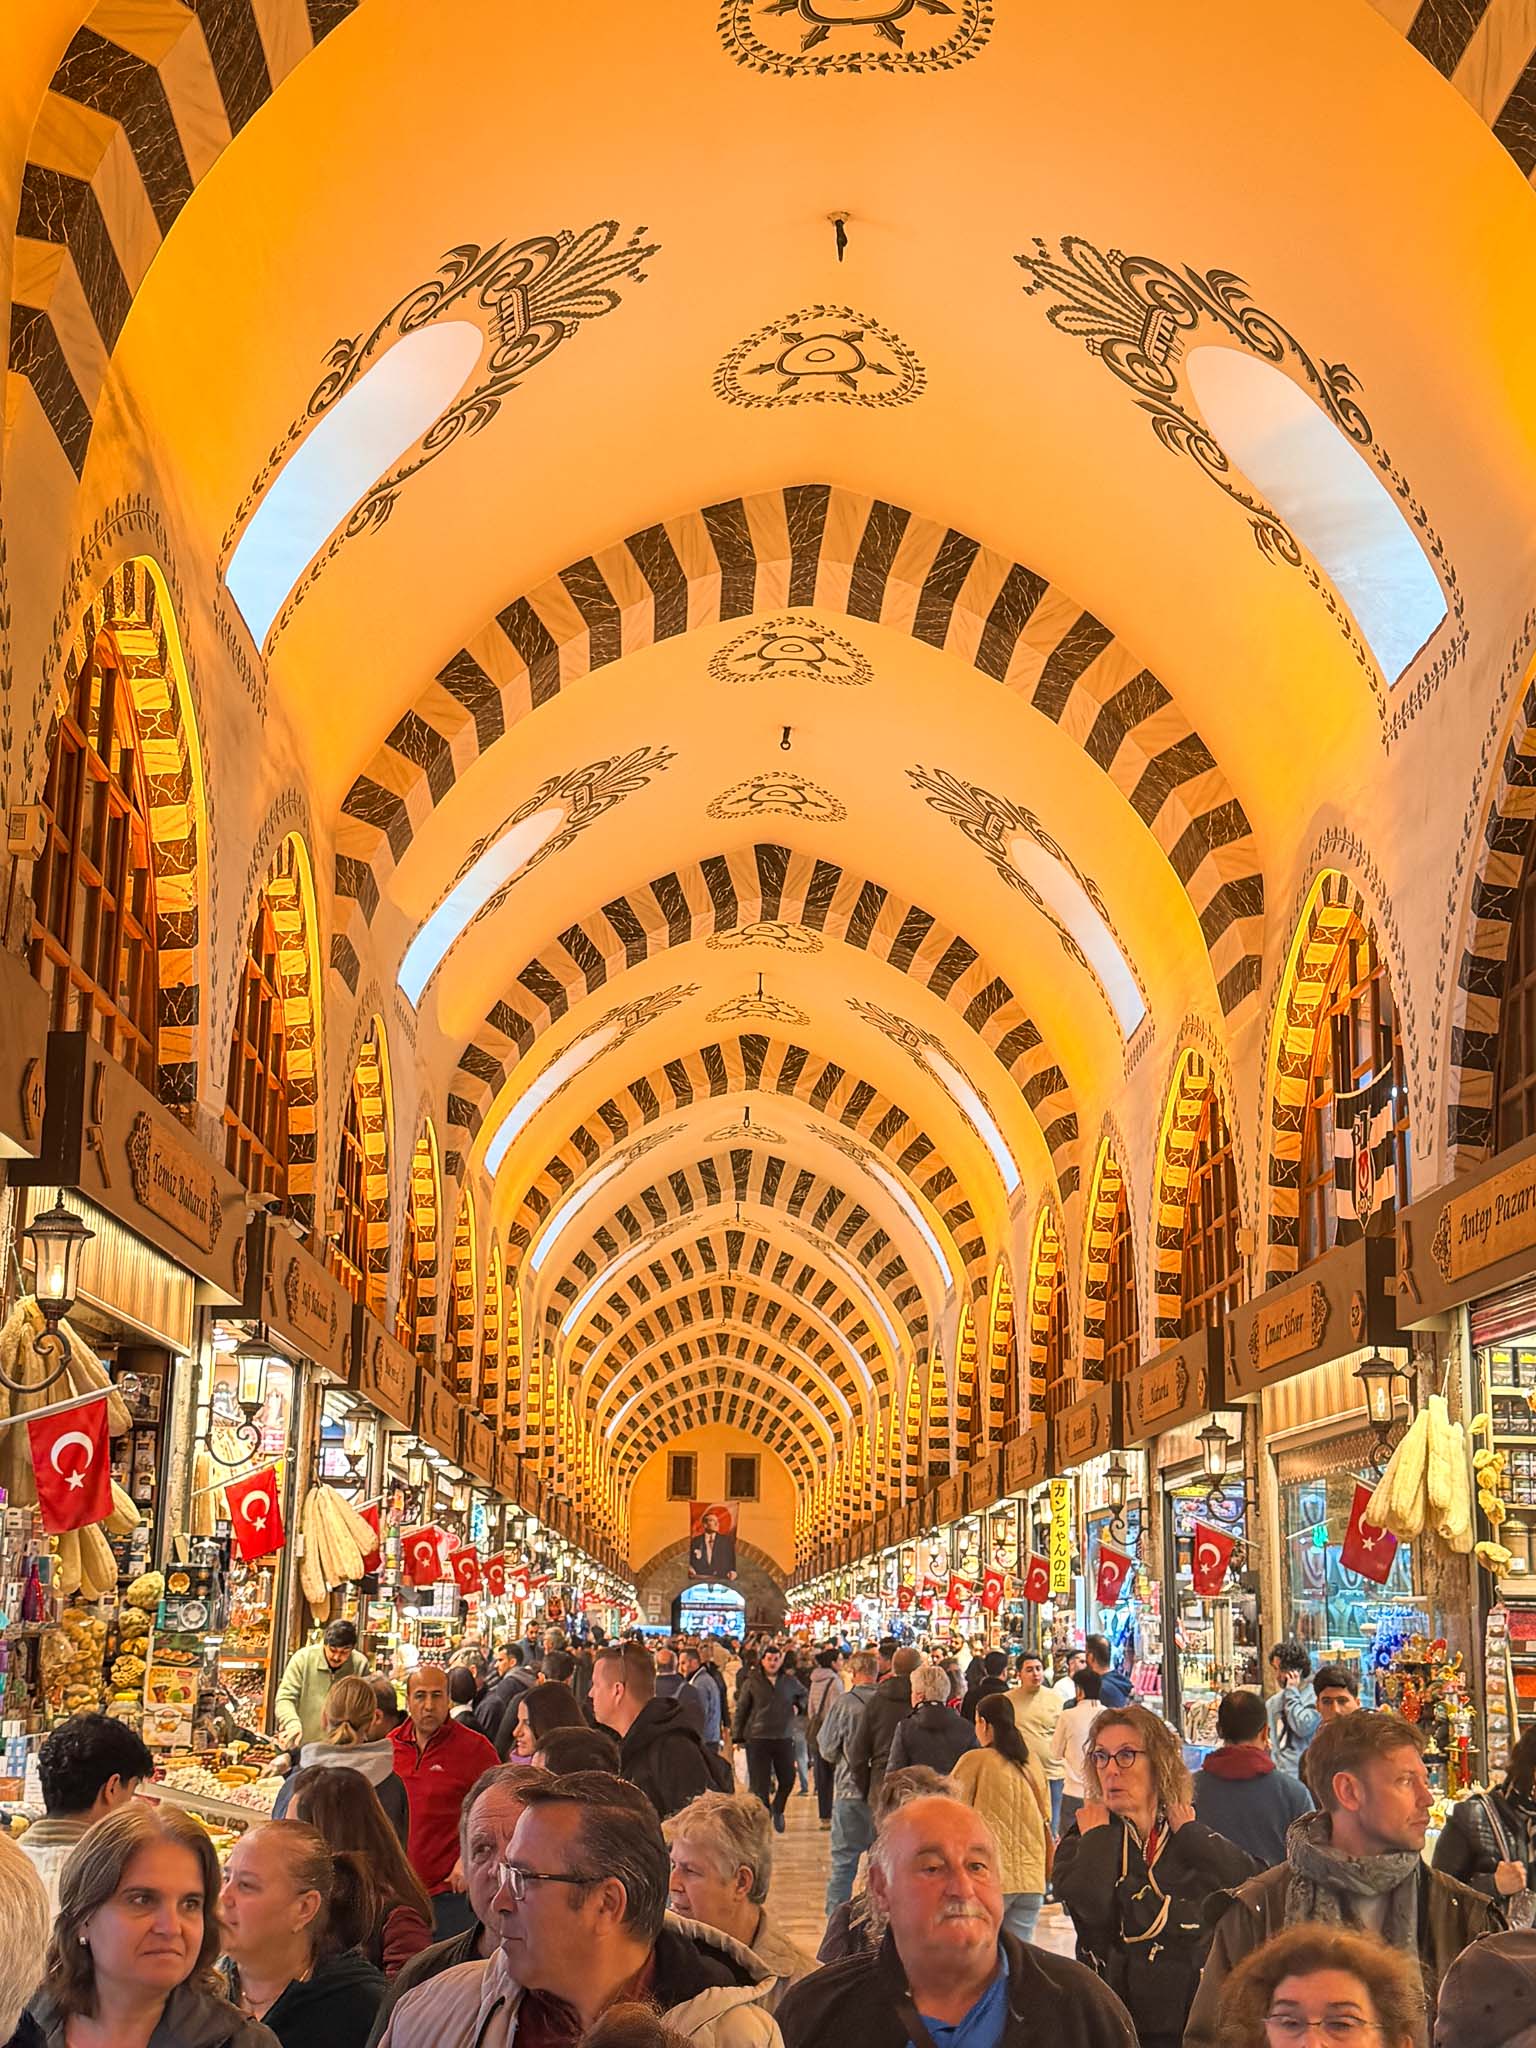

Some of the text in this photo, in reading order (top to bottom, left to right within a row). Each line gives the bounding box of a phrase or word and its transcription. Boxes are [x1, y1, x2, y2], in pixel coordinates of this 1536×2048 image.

[32, 1083, 42, 1117] 41
[153, 1152, 209, 1224] Temiz Baharat
[1458, 1206, 1492, 1245] Antep
[1283, 1307, 1304, 1339] Silver
[1351, 1304, 1361, 1328] 52
[1053, 1483, 1067, 1588] カンちゃんの店
